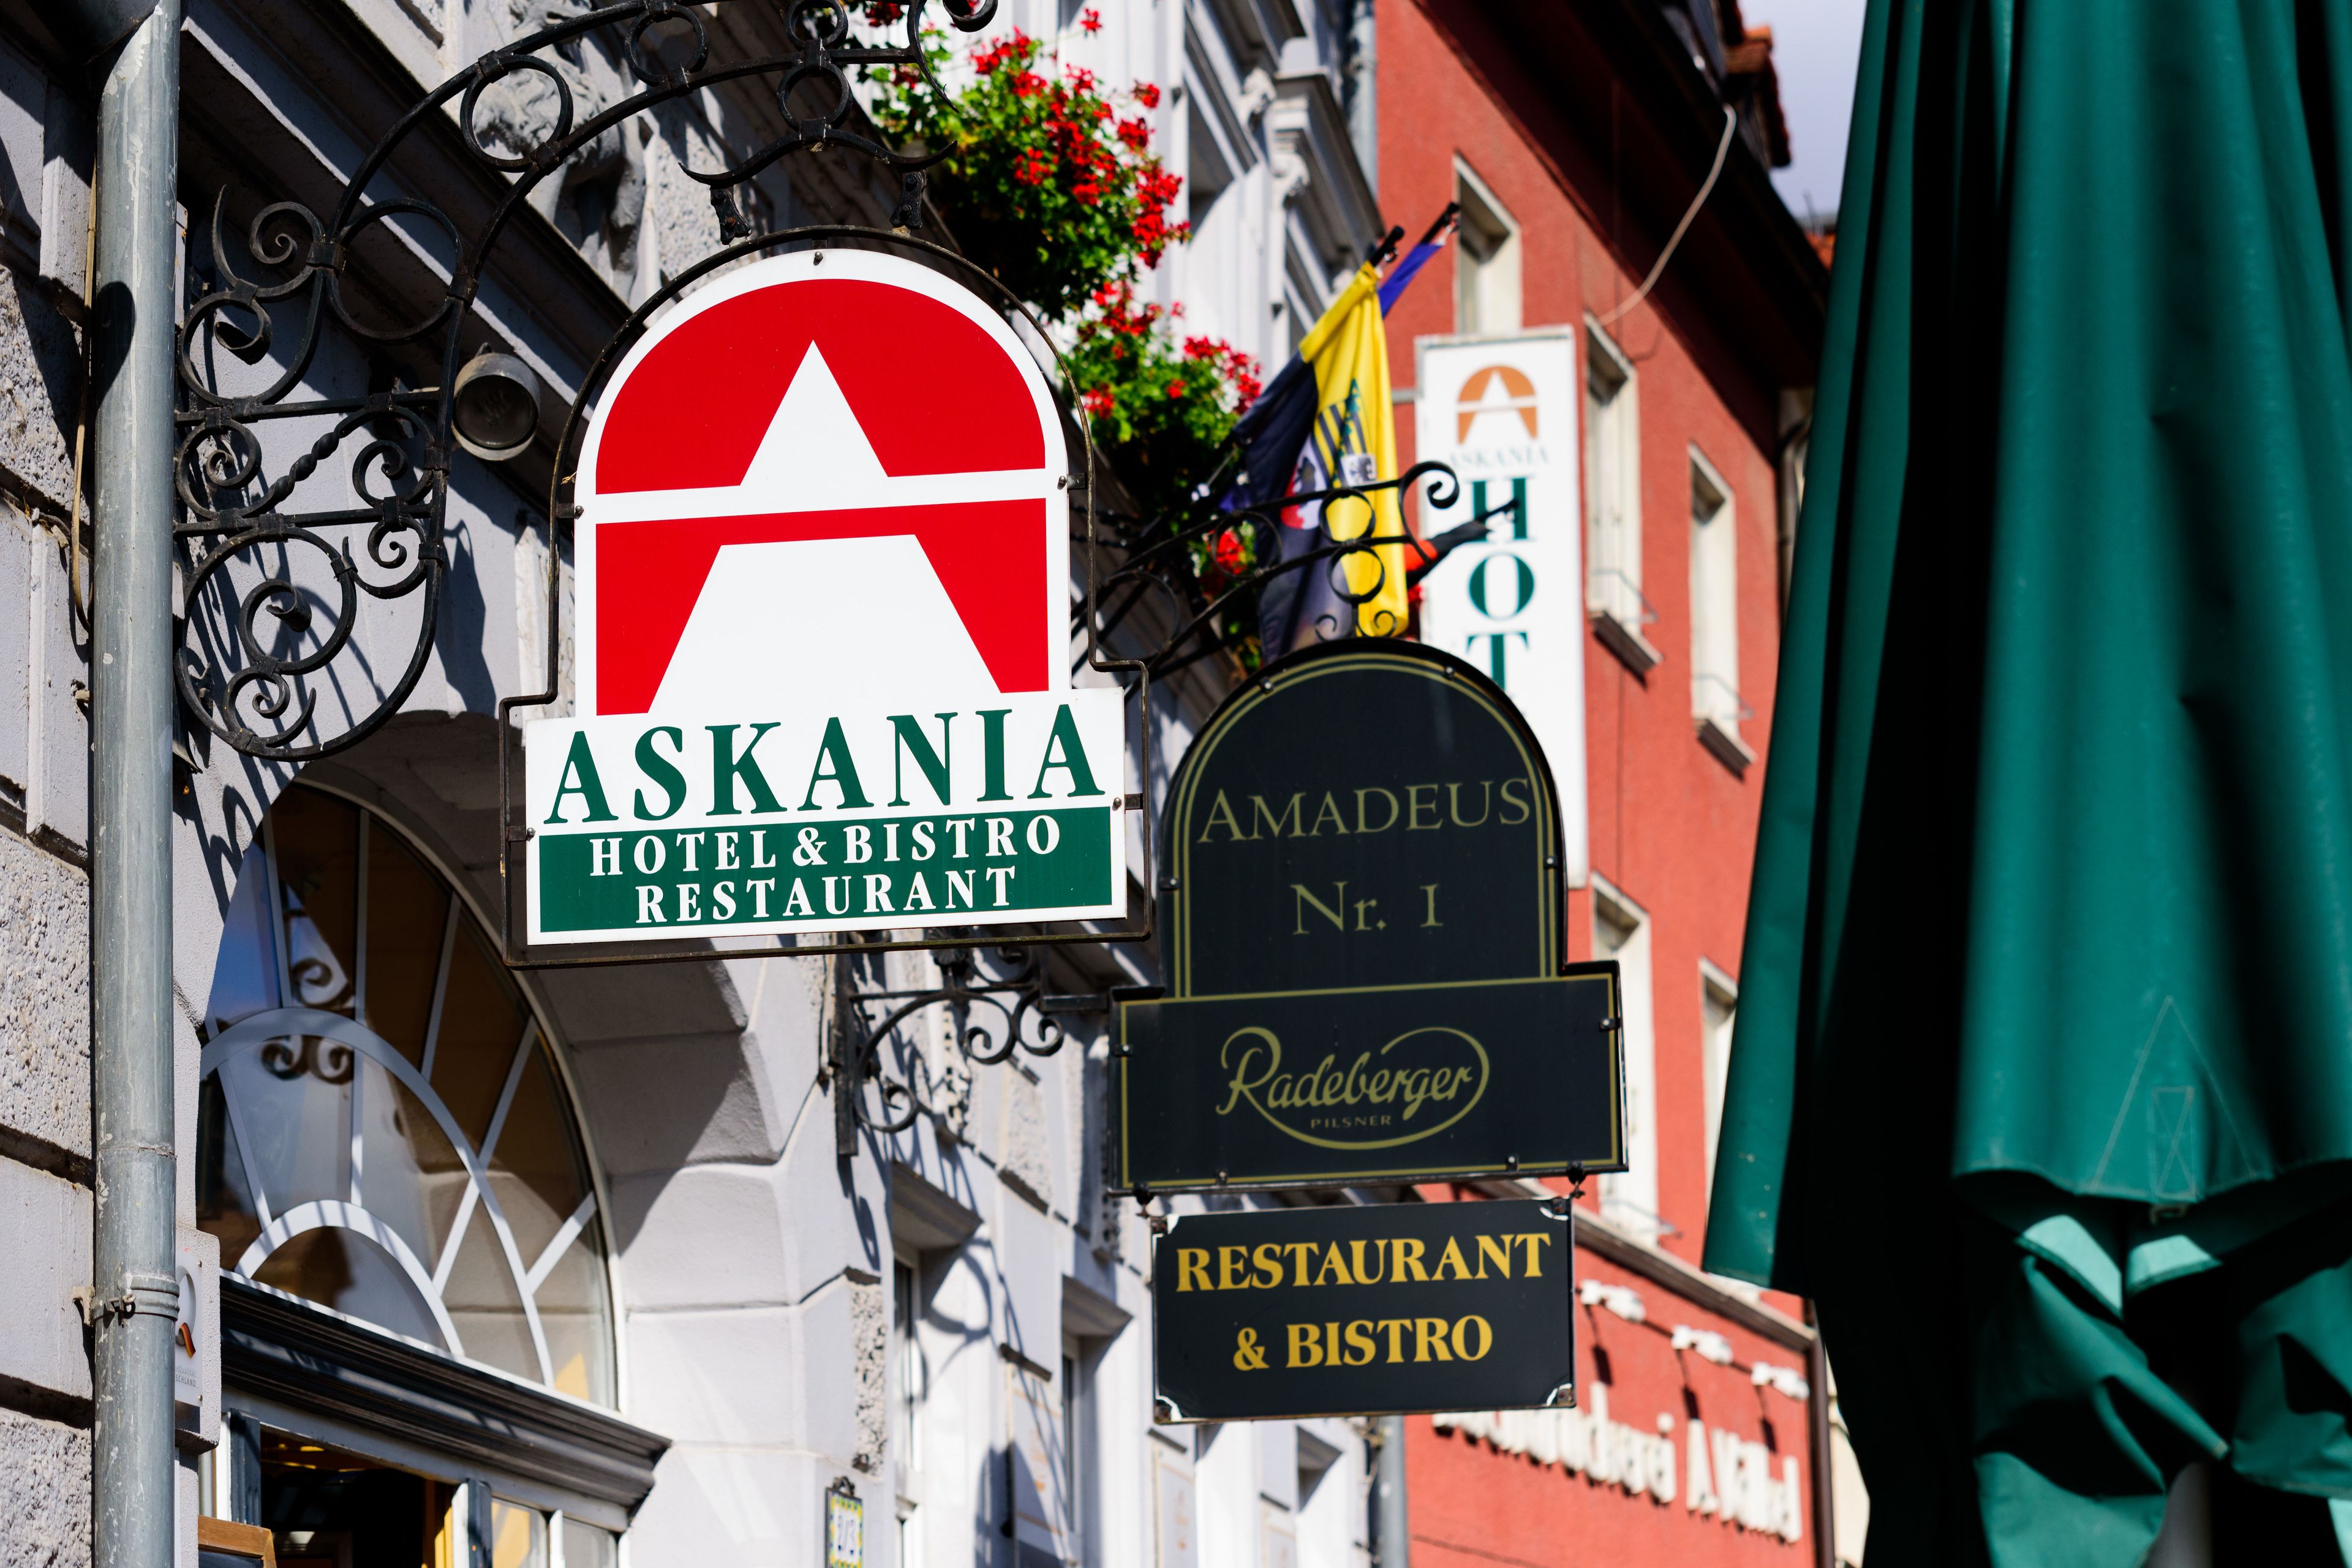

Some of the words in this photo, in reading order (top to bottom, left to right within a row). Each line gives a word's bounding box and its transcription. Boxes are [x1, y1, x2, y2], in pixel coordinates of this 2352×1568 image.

[1460, 473, 1536, 695] HOT
[544, 704, 1105, 824] ASKANIA
[1197, 777, 1531, 843] AMADEUS
[589, 831, 777, 877] HOTEL
[792, 826, 828, 867] &
[843, 814, 1060, 865] BISTRO
[635, 865, 1016, 924] RESTAURANT
[1290, 881, 1387, 935] Nr.
[1216, 1027, 1477, 1122] Radeberger
[1311, 1115, 1392, 1129] PILSNER
[1176, 1232, 1551, 1293] RESTAURANT
[1233, 1327, 1270, 1371] &
[1286, 1314, 1493, 1369] BISTRO
[175, 1374, 196, 1387] SCHLAND
